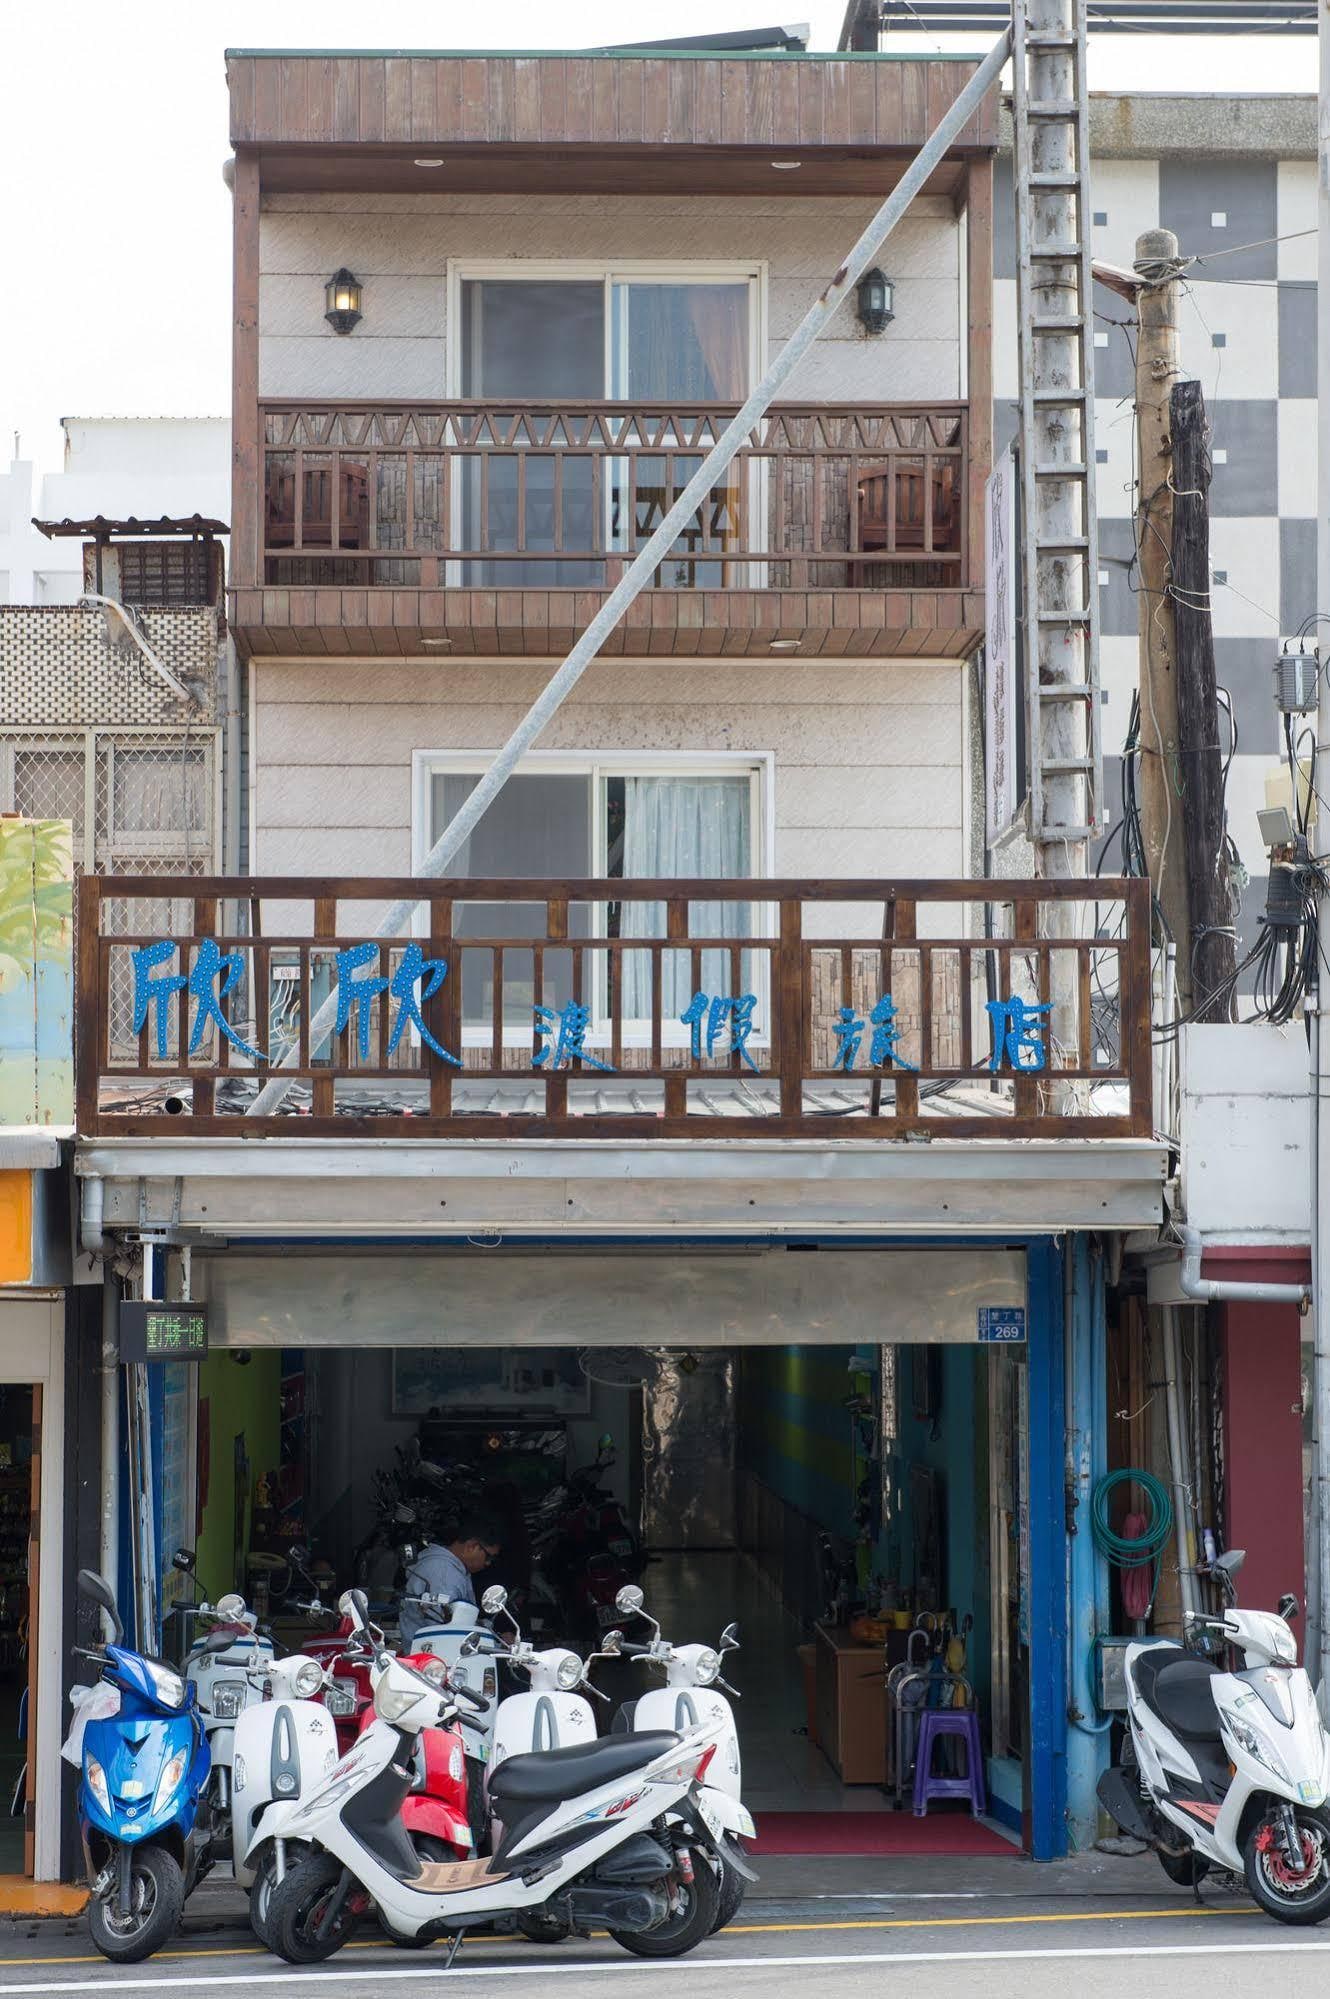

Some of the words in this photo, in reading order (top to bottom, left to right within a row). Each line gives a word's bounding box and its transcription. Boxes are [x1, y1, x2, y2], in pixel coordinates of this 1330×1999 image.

[131, 939, 1052, 1072] 欣欣渡假旅店
[995, 1327, 1019, 1338] 269
